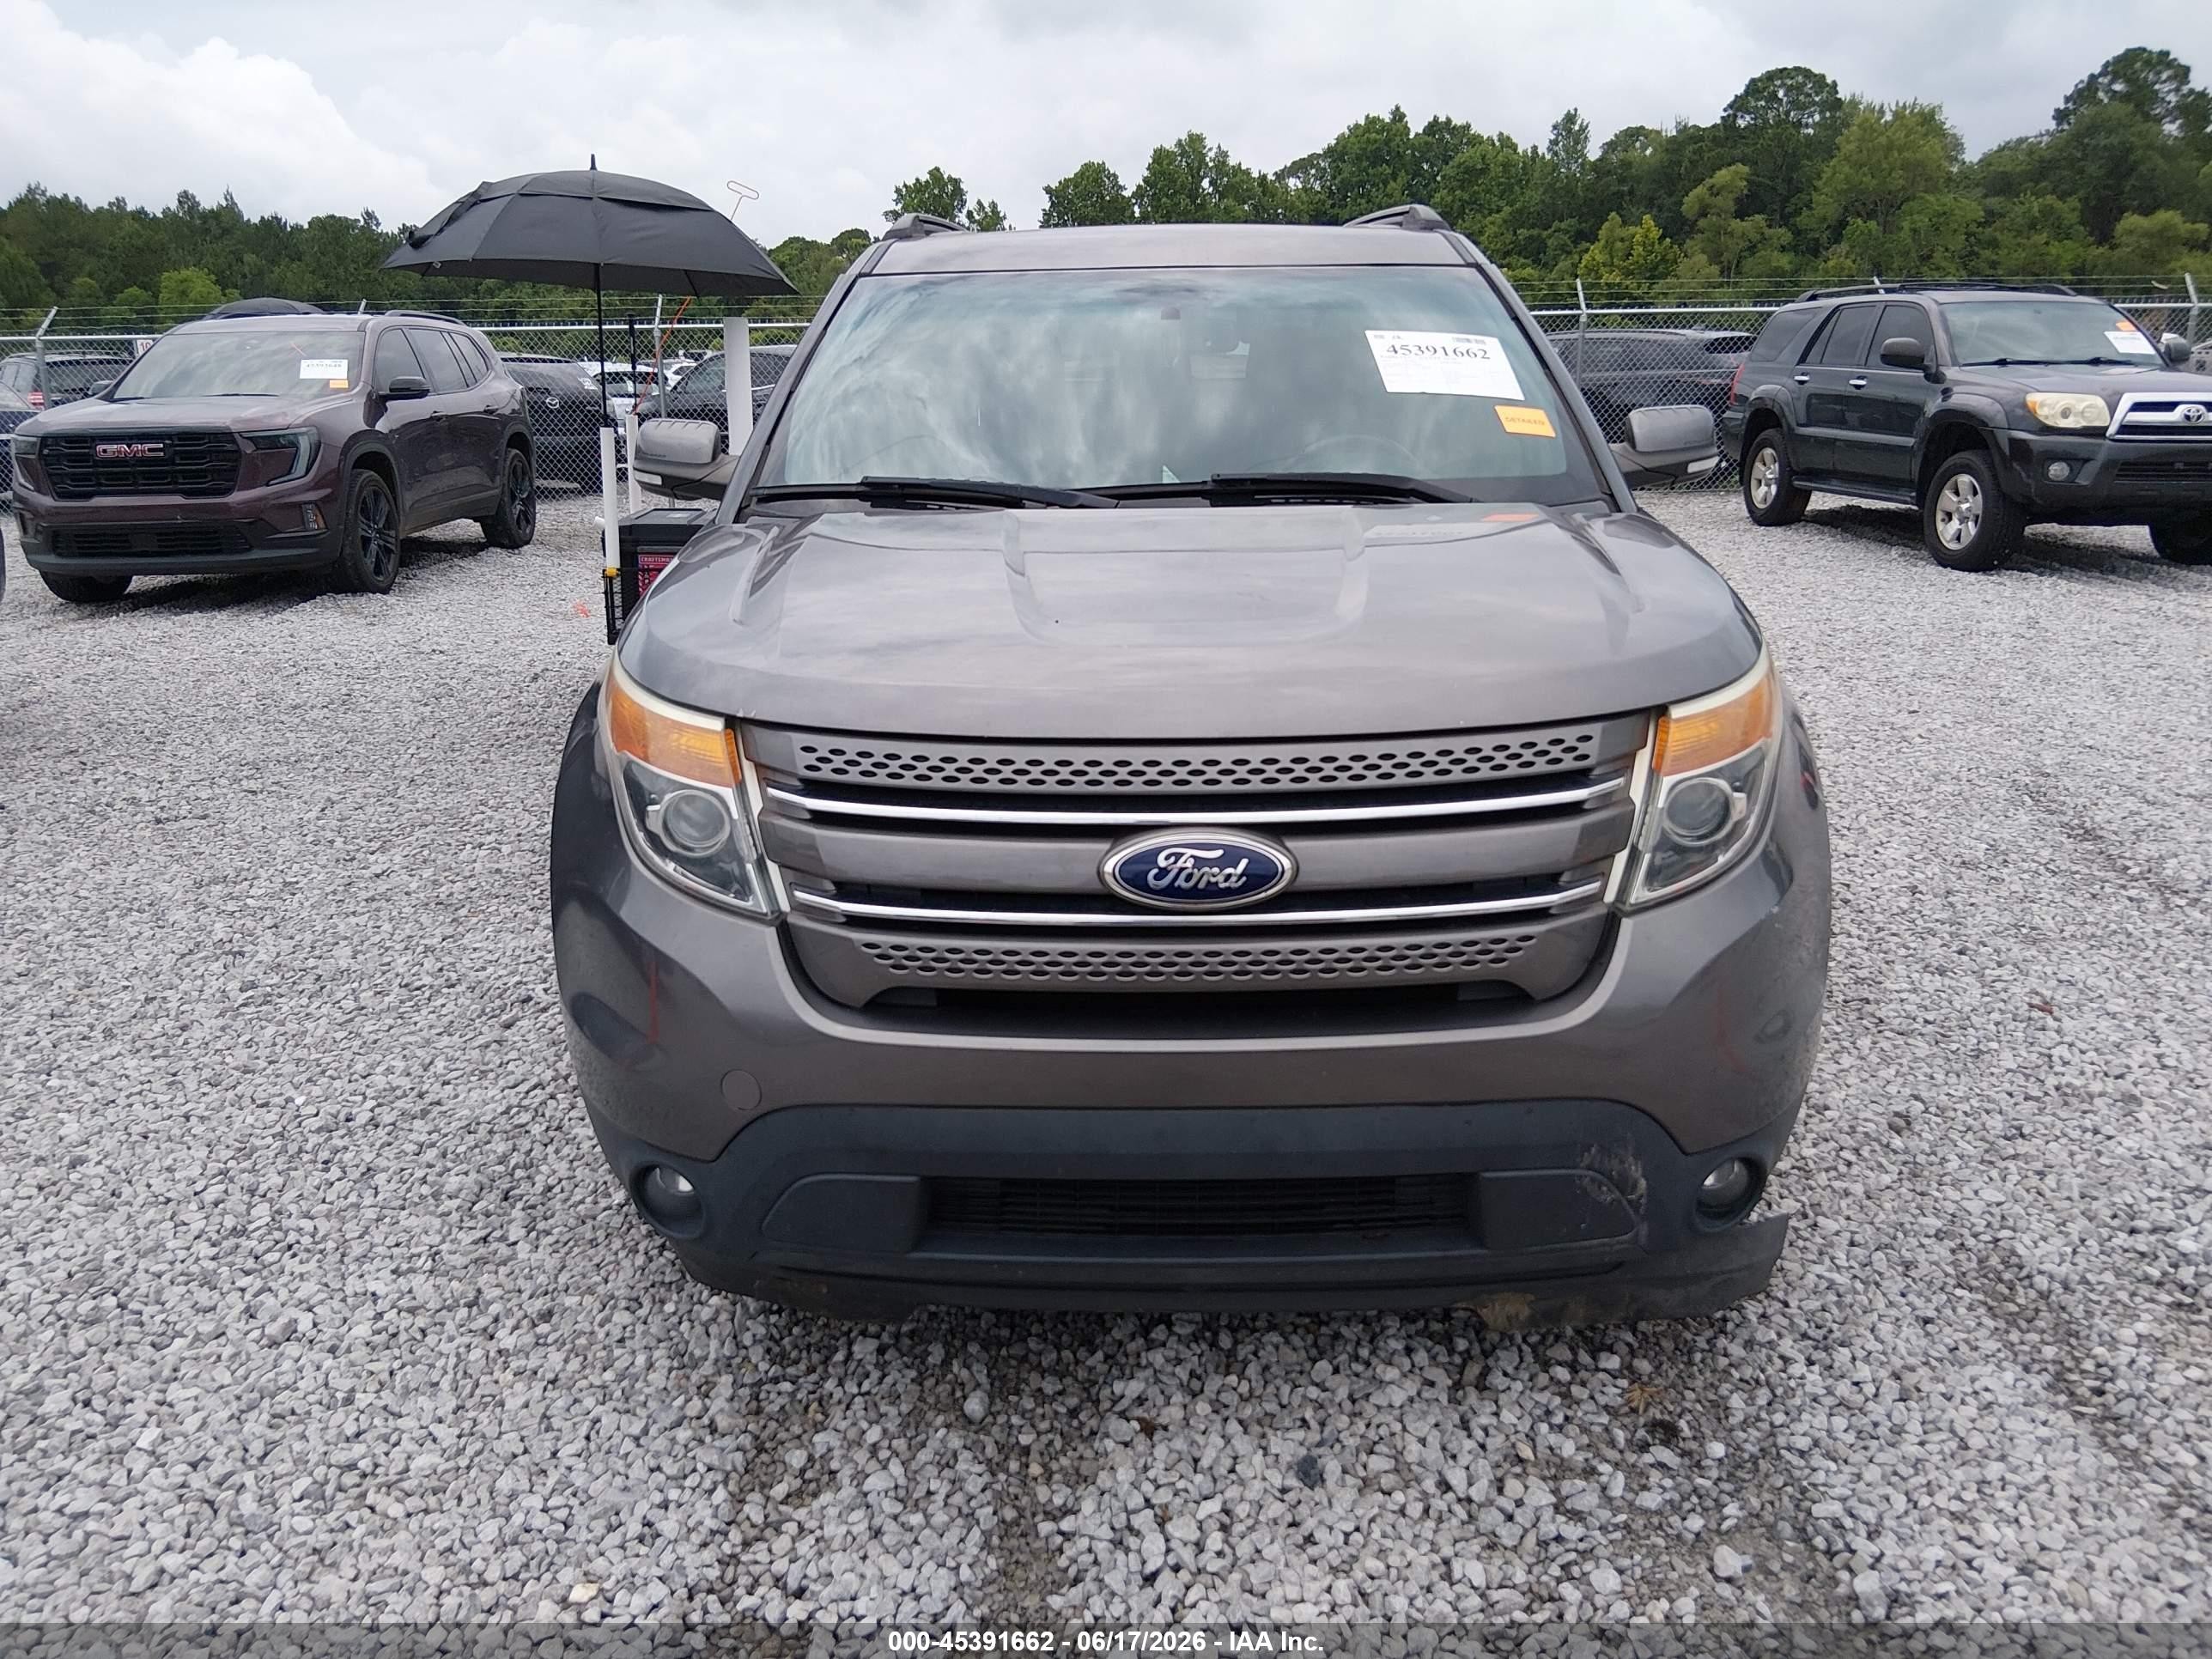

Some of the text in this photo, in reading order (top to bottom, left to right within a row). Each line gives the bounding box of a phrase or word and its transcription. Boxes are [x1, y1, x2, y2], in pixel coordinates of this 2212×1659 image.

[1387, 344, 1491, 360] 45391662
[97, 444, 165, 458] GMC
[1147, 848, 1249, 890] Ford
